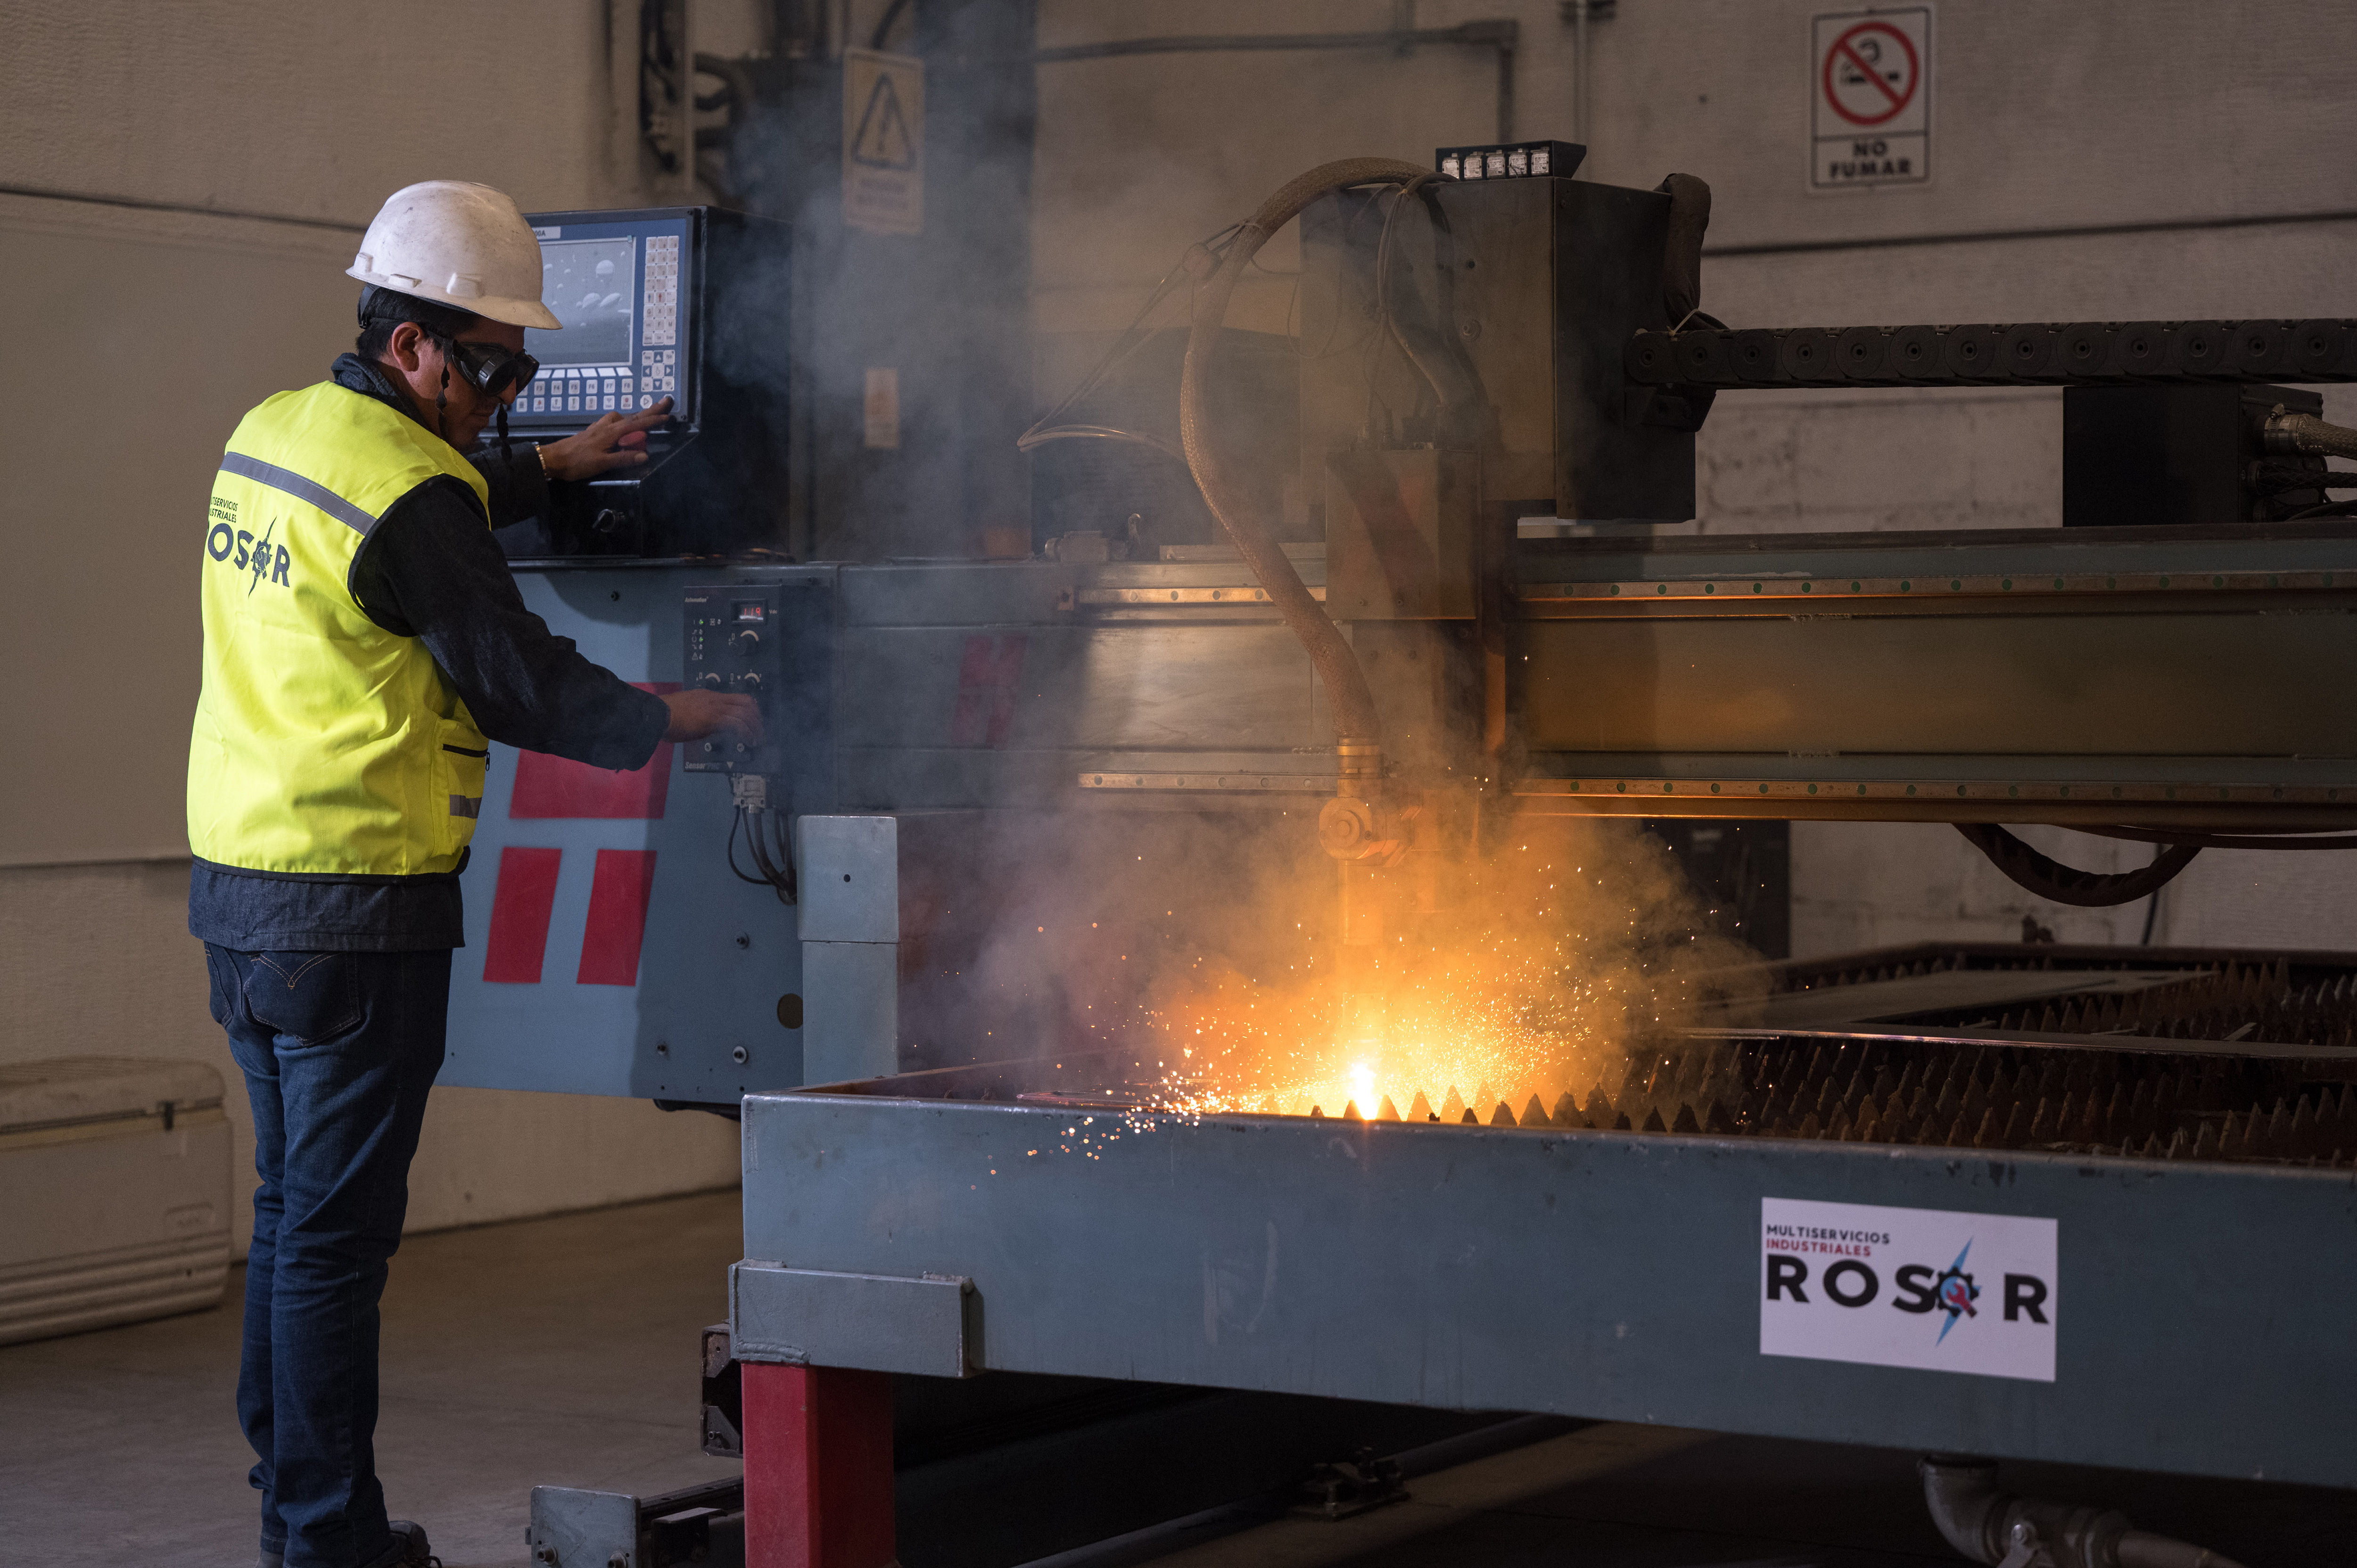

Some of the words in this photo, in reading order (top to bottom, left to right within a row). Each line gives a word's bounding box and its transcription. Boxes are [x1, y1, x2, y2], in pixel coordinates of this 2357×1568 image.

[1854, 141, 1887, 156] NO
[1830, 159, 1911, 178] FUMAR
[743, 607, 761, 616] 119
[685, 761, 706, 770] Sensor
[1766, 1224, 1890, 1245] MULTISERVICIOS
[1766, 1239, 1871, 1257] INDUSTRIALES
